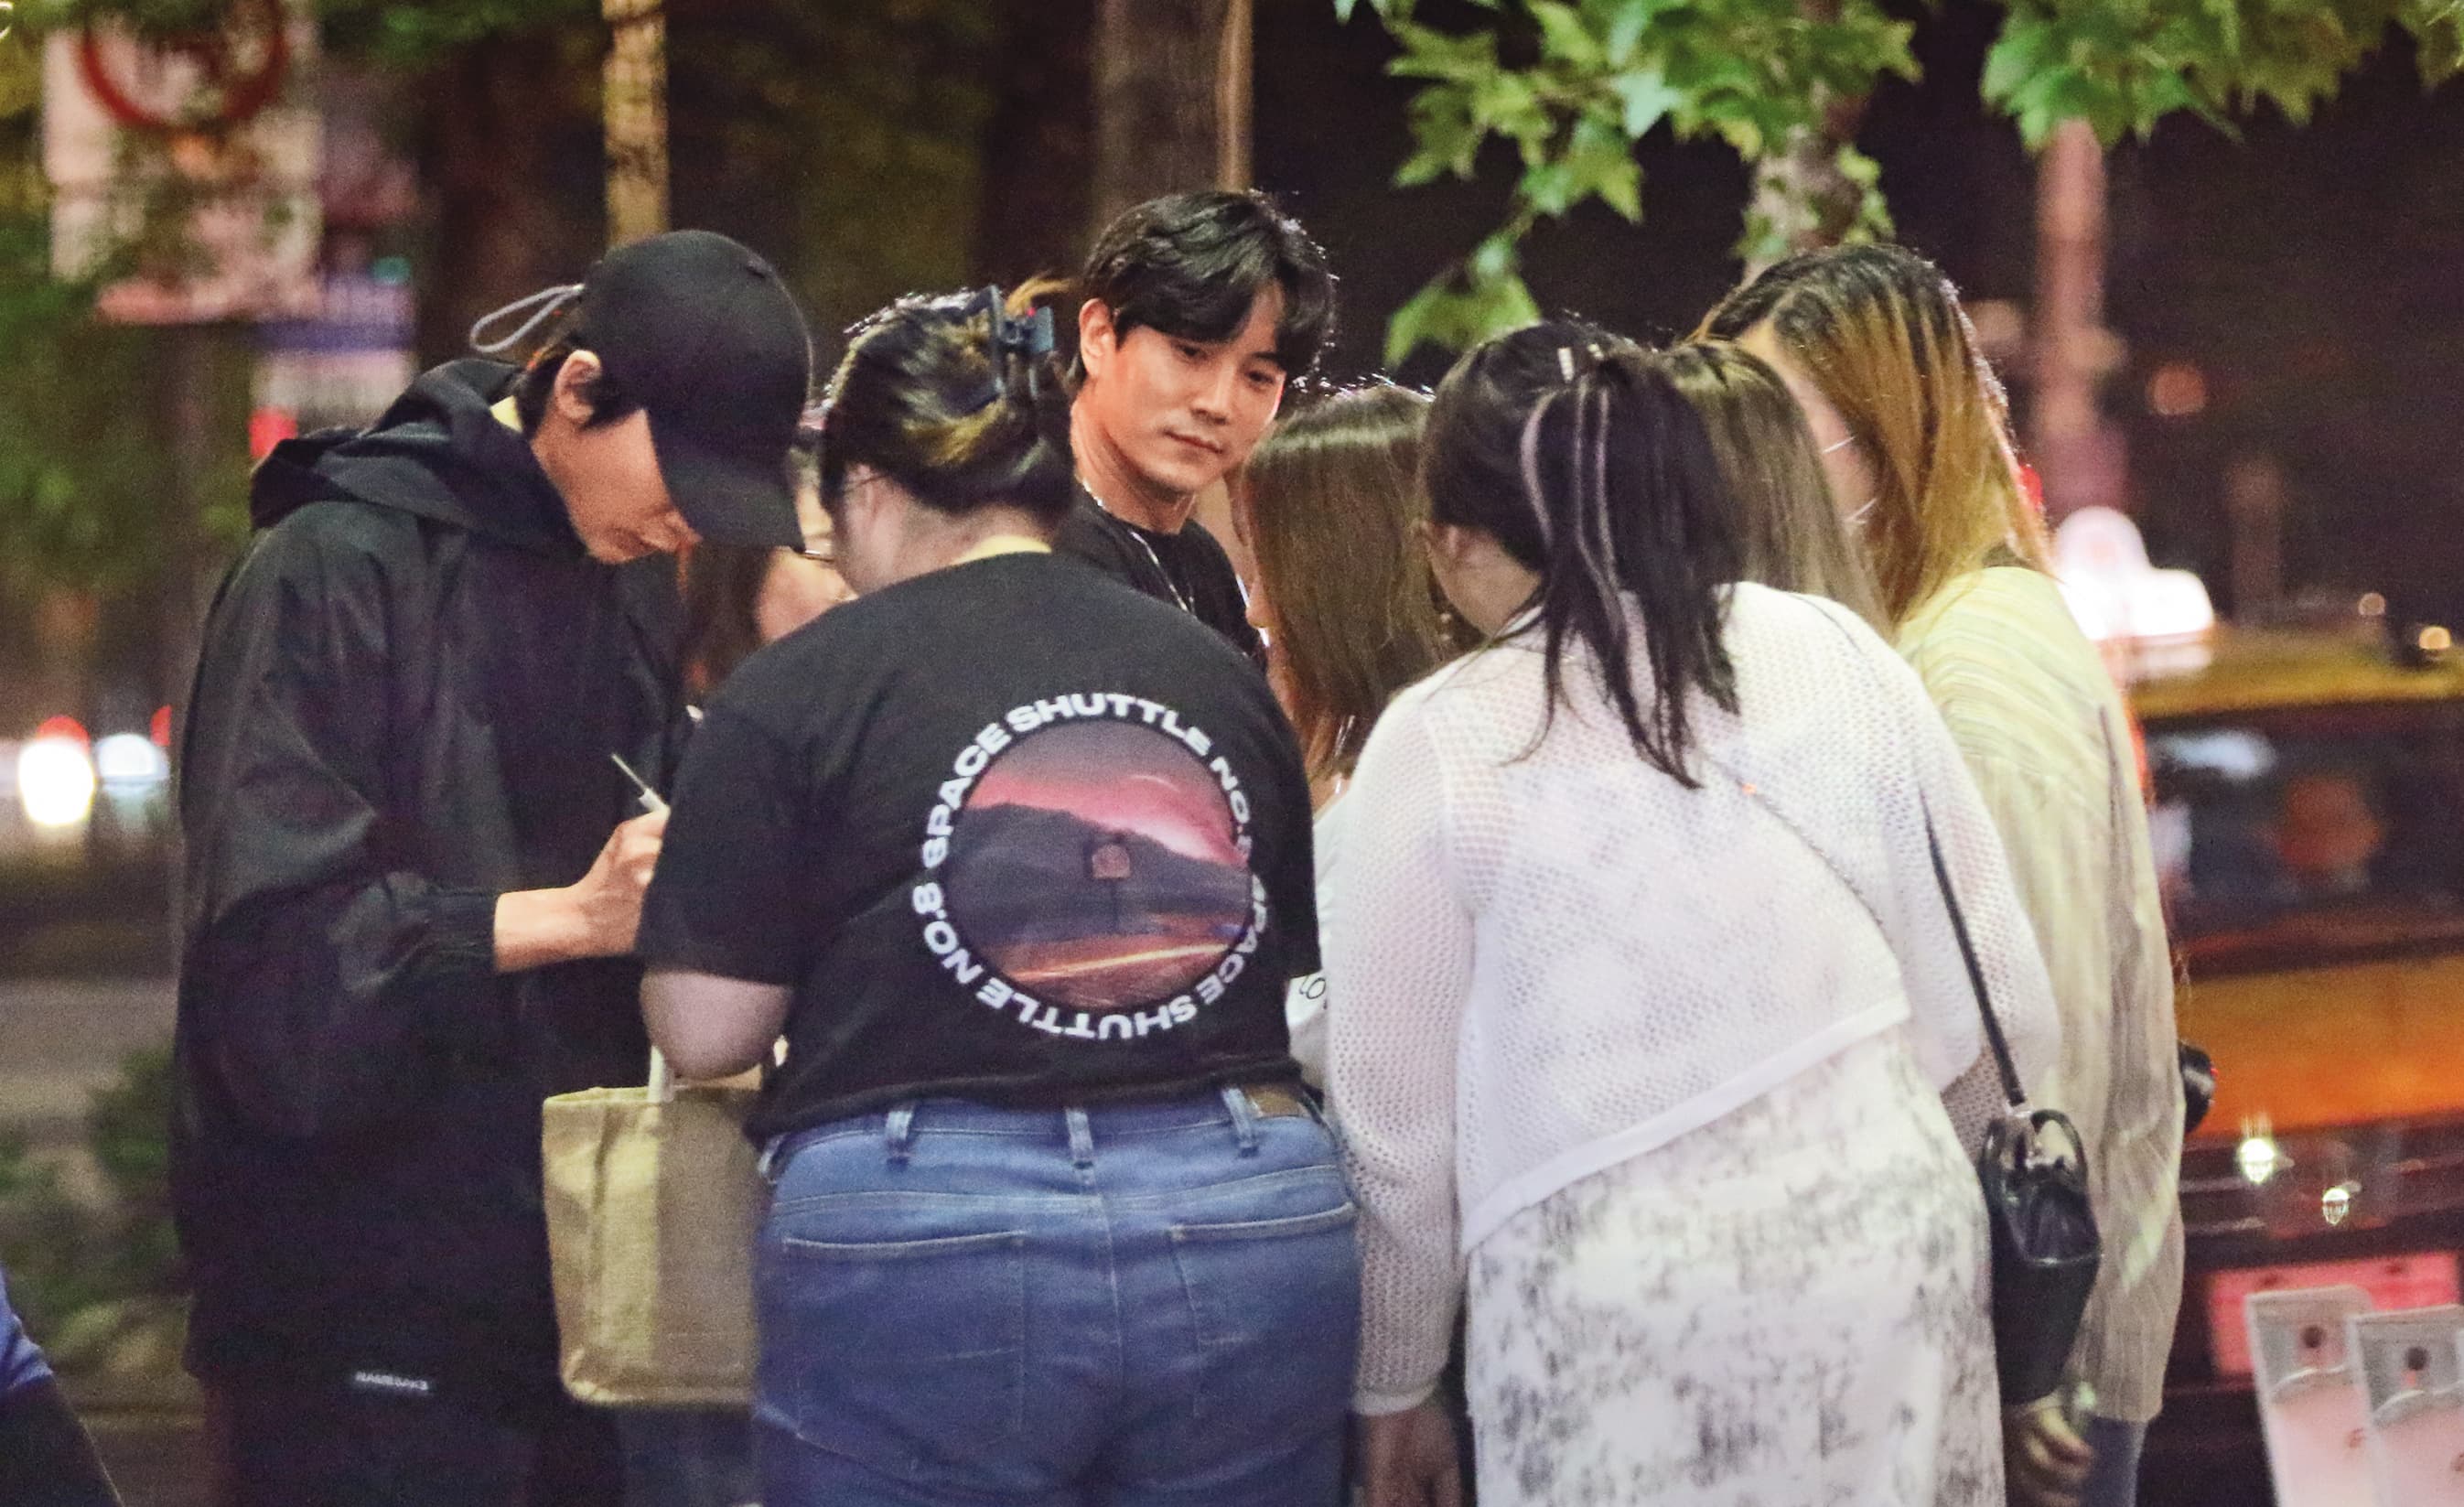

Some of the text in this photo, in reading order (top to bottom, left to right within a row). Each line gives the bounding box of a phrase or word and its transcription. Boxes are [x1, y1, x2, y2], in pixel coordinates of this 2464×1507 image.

[923, 723, 1011, 868] SPACE
[1006, 693, 1212, 757] SHUTTLE
[913, 881, 983, 985] NO.8
[975, 978, 1198, 1040] SHUTTLE
